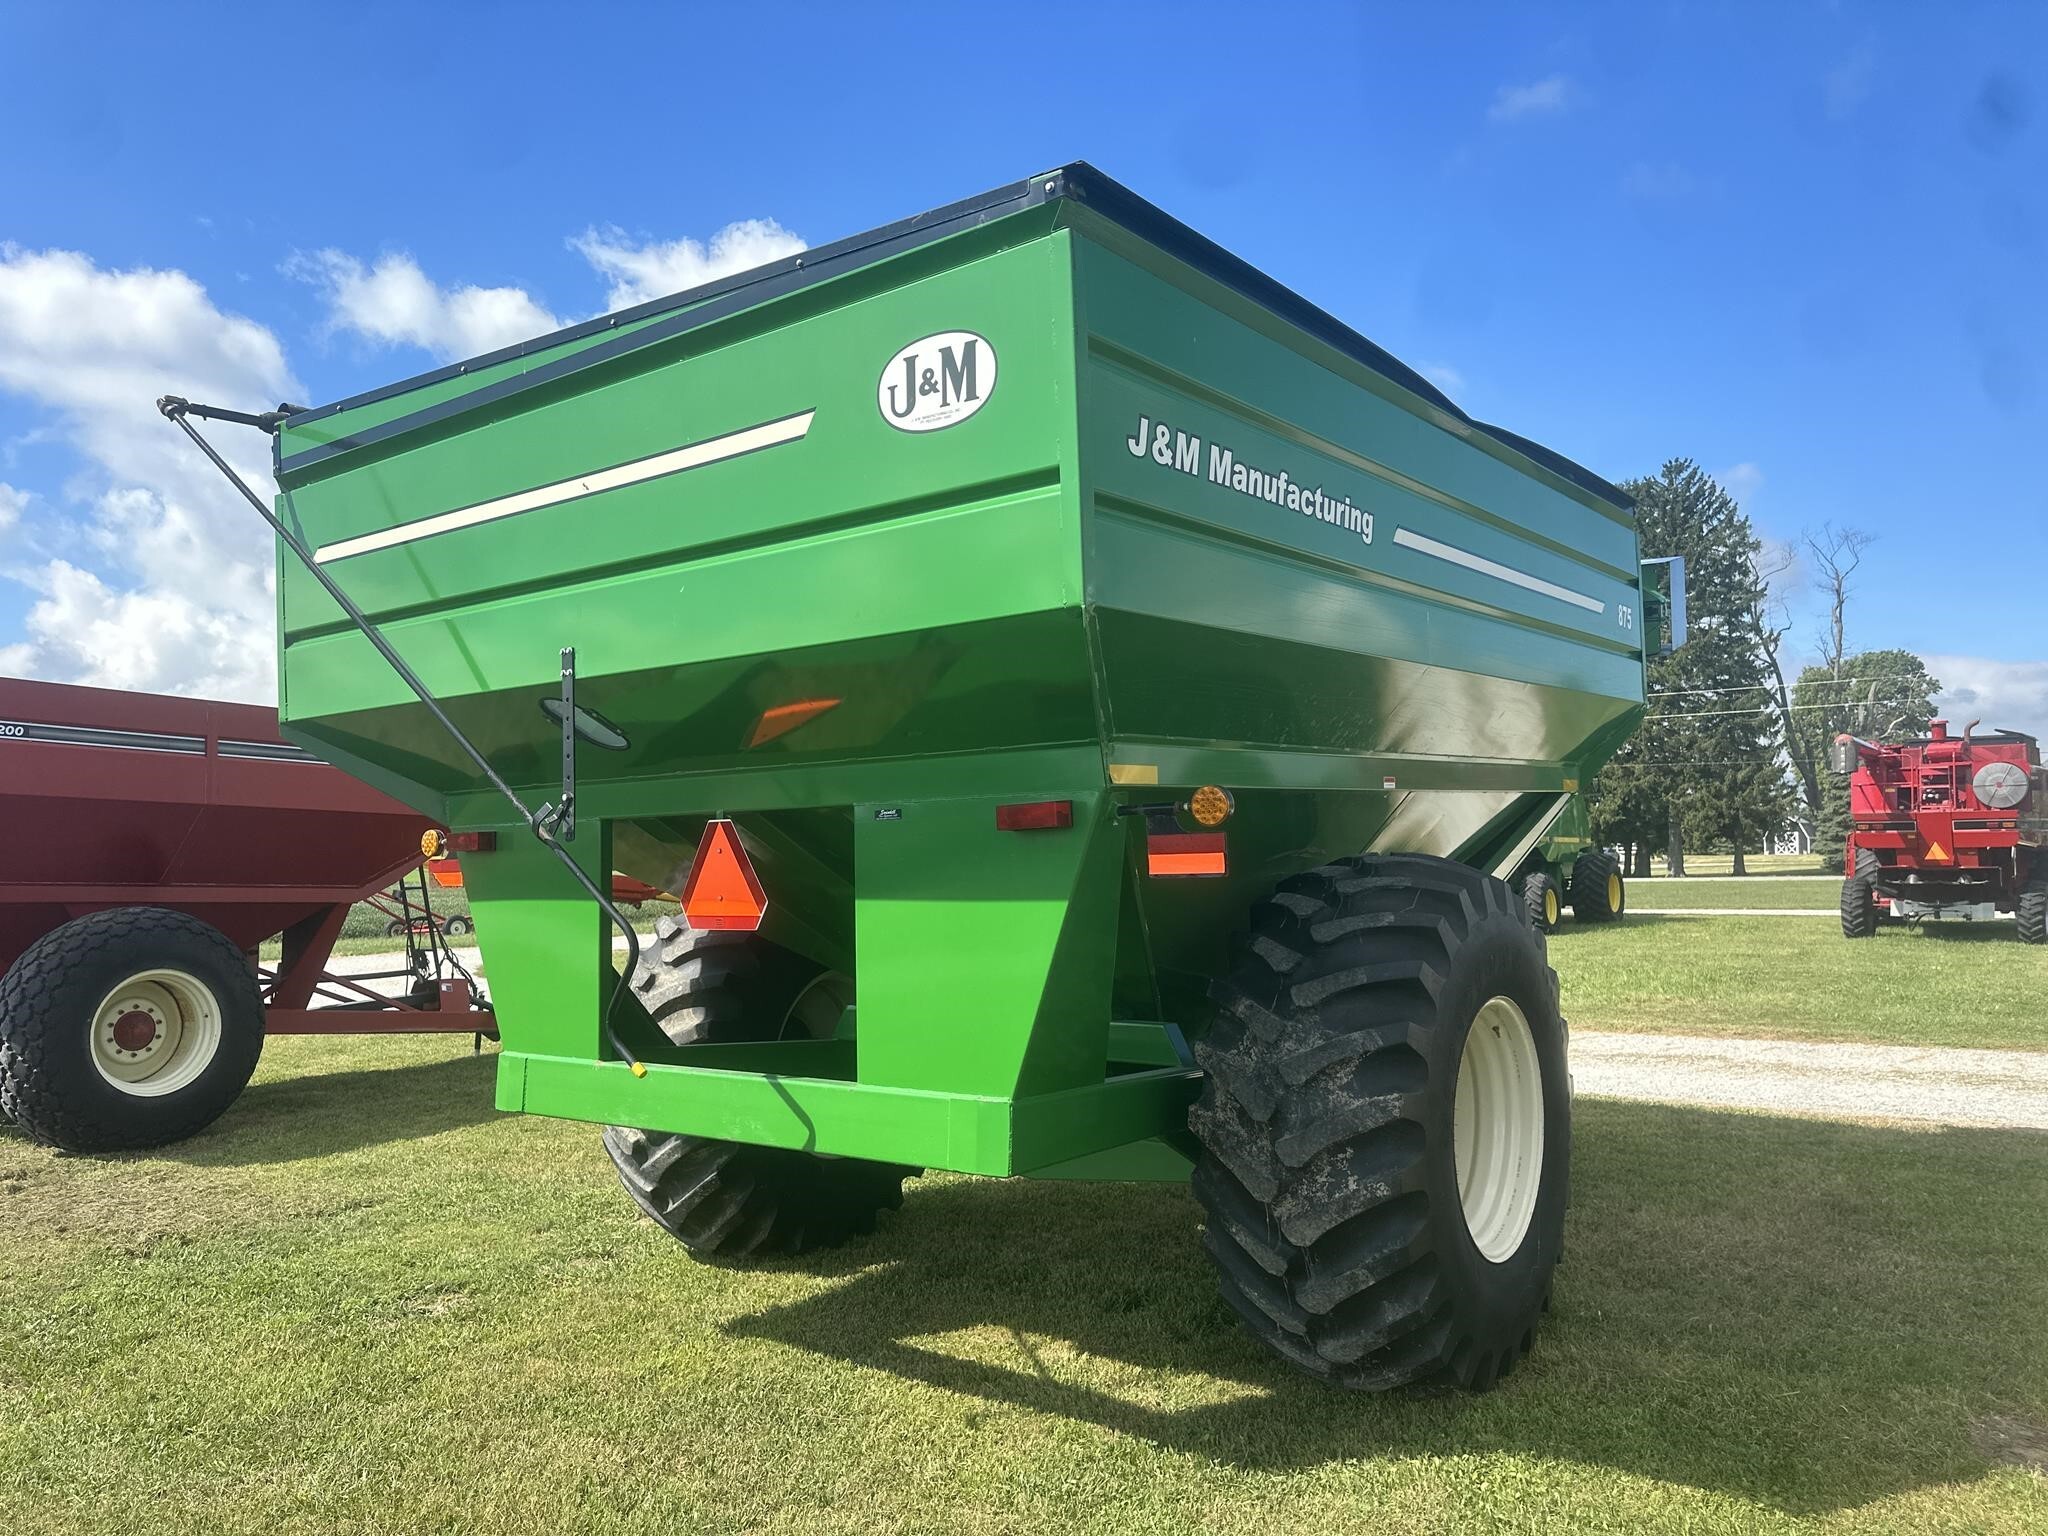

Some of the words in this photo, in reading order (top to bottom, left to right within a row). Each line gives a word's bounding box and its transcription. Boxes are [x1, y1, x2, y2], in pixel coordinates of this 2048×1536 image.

[887, 339, 980, 418] J&M
[1127, 416, 1201, 476] J&M
[1208, 444, 1375, 545] Manufacturing
[1618, 604, 1632, 630] 875
